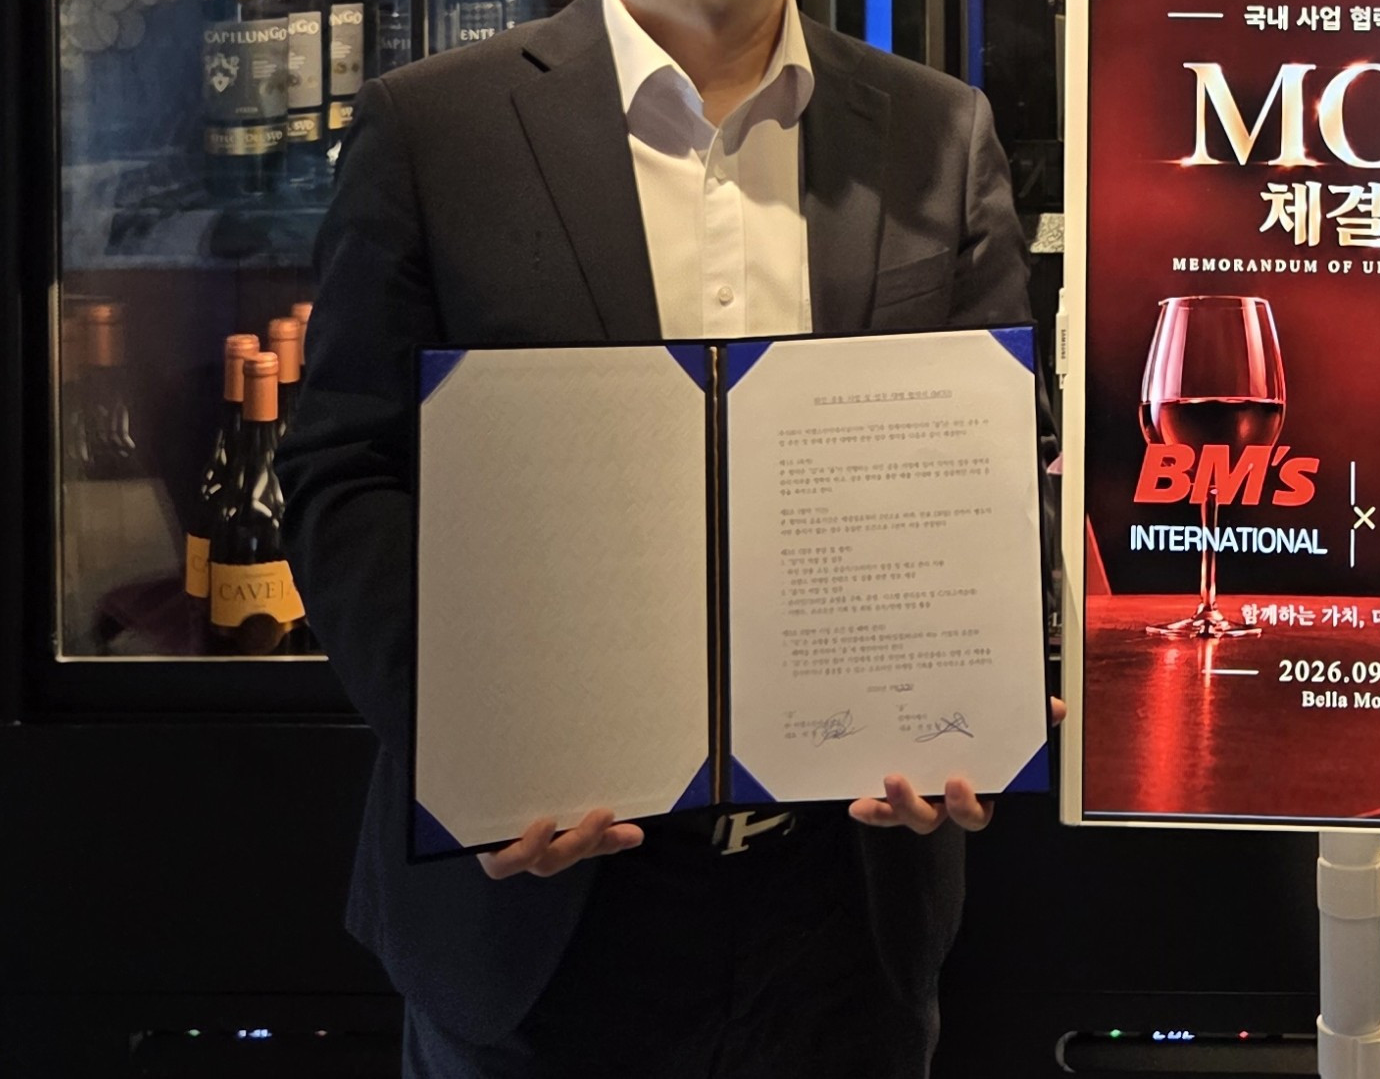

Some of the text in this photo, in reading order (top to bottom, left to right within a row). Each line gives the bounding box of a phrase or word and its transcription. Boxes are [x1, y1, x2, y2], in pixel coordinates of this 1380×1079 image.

[1243, 5, 1289, 31] 국내
[1296, 5, 1341, 31] 사업
[1172, 257, 1318, 274] MEMORANDUM
[1327, 260, 1353, 274] OF
[1133, 442, 1321, 508] BM's
[1130, 524, 1328, 556] INTERNATIONAL
[1240, 603, 1316, 628] 함께하는
[1321, 605, 1365, 629] 가치,
[1302, 690, 1348, 708] Bella
